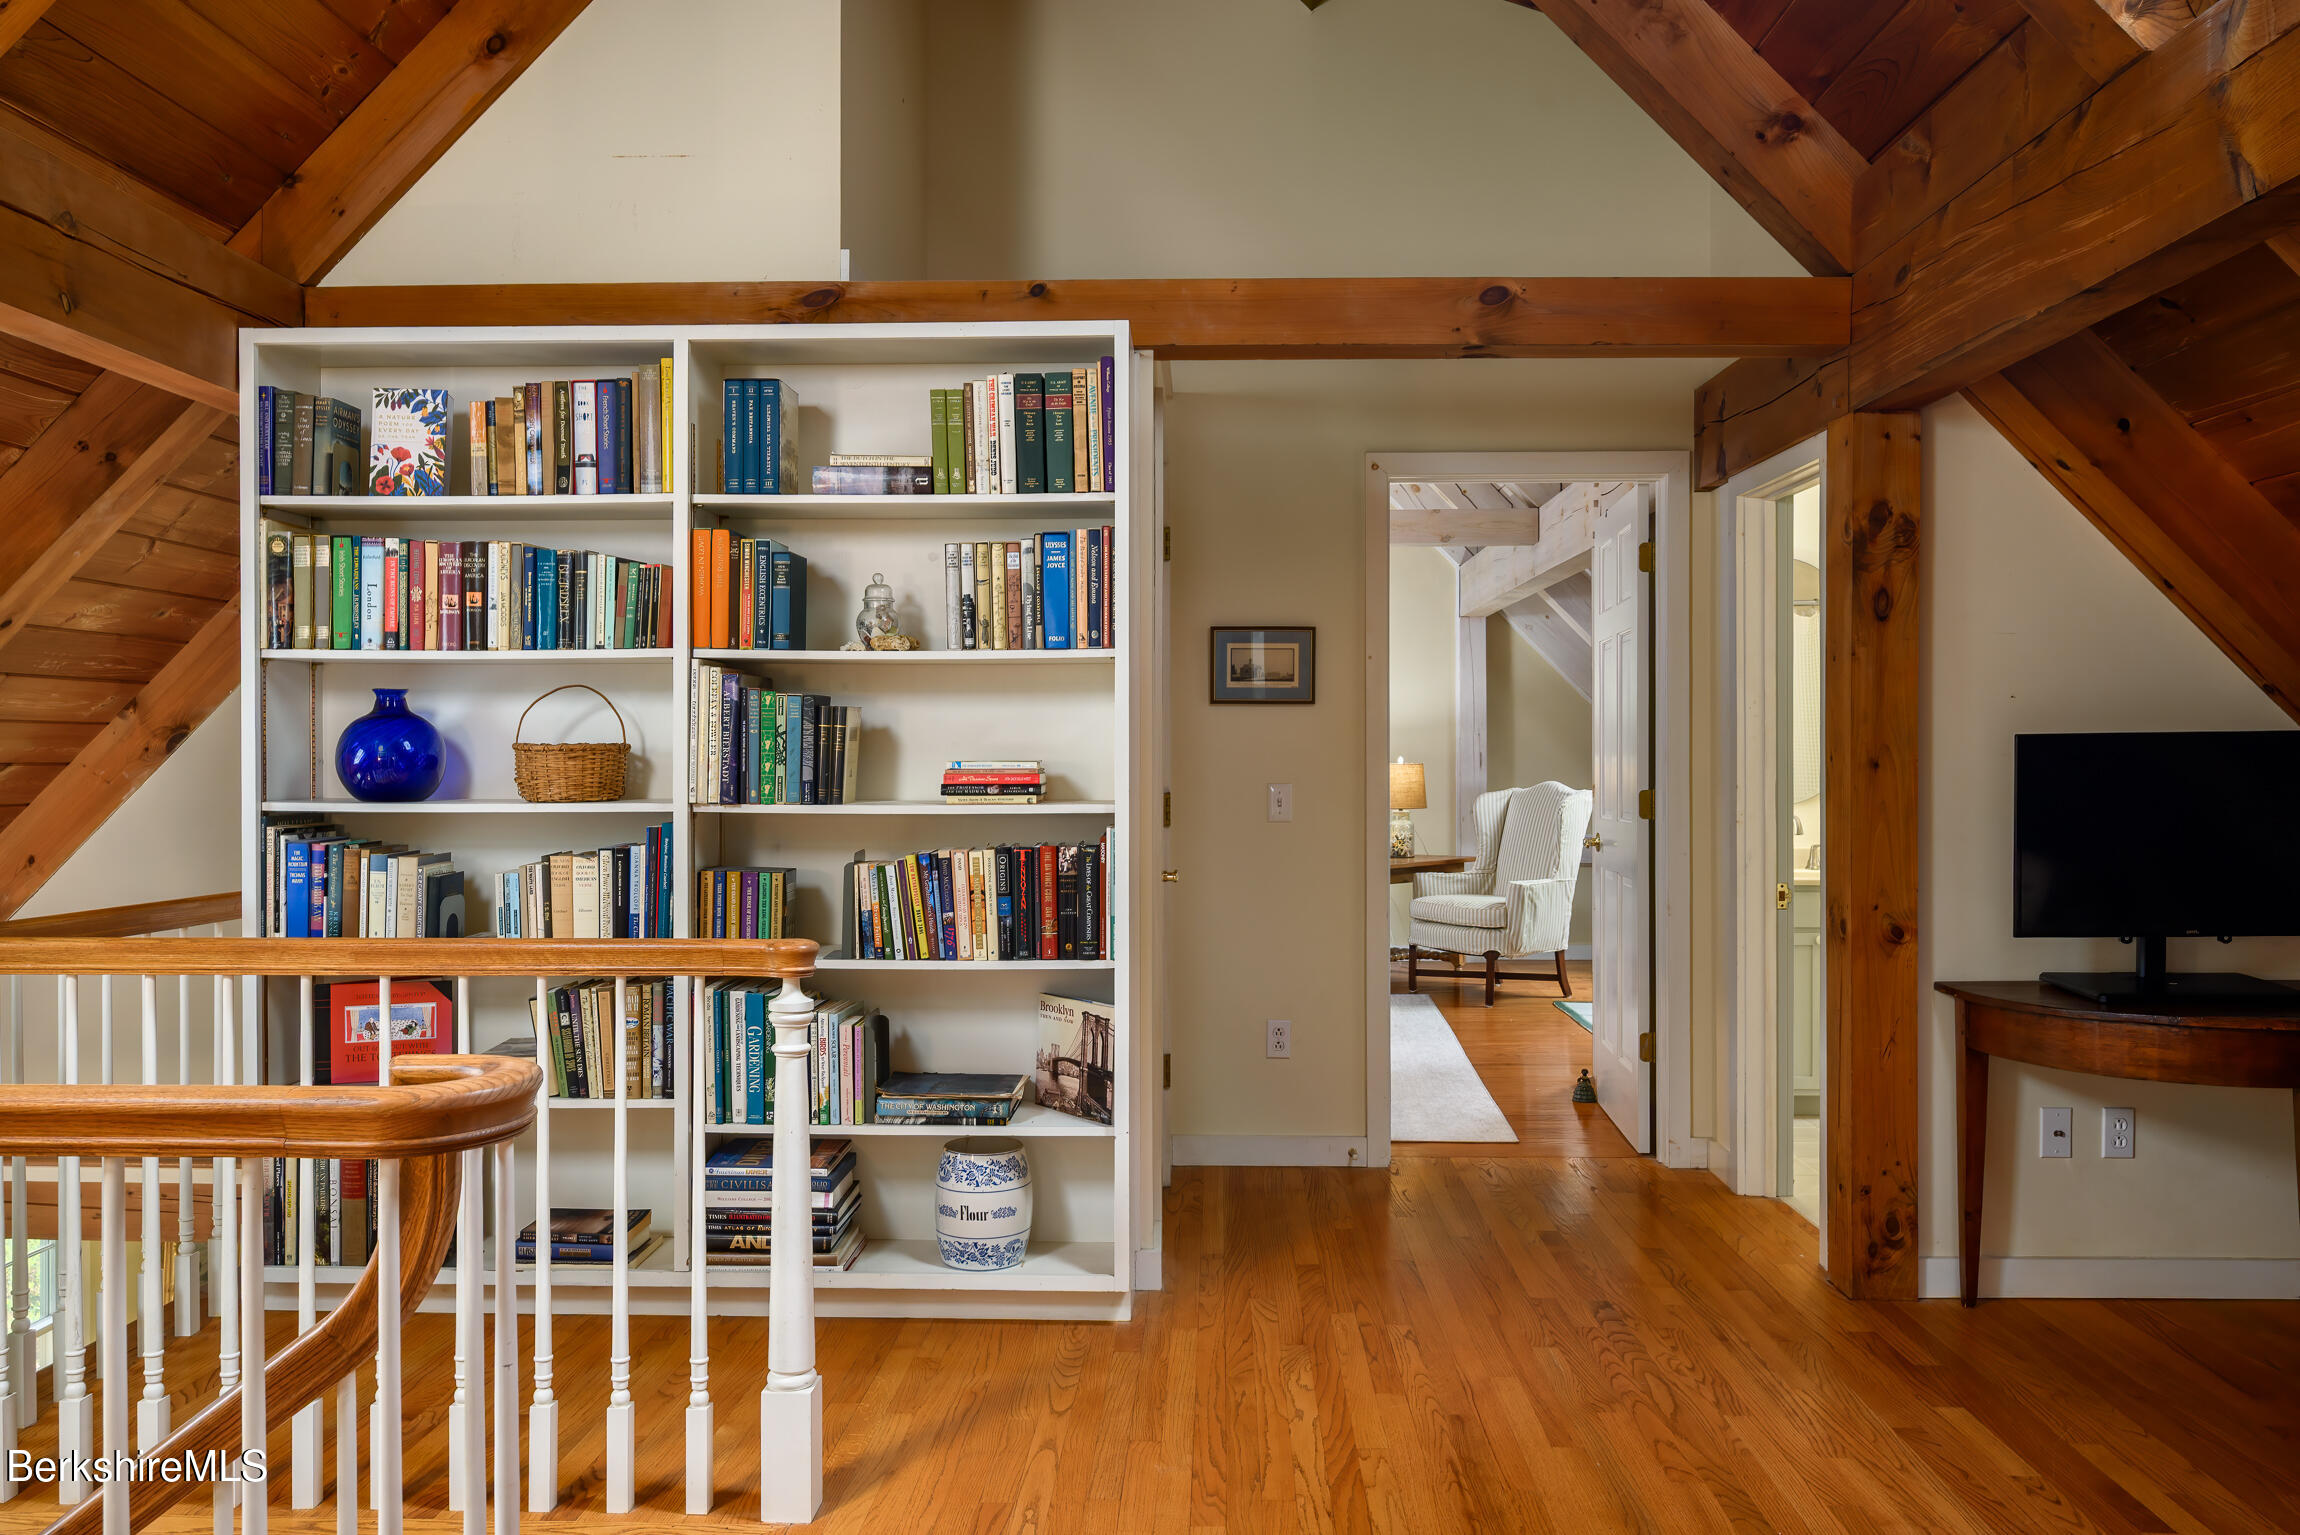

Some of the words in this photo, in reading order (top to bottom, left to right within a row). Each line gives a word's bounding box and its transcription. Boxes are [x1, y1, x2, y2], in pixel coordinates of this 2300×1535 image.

[1089, 384, 1097, 415] AVENUE
[332, 416, 362, 435] ODYSSEY
[1091, 429, 1100, 477] PRESIDENTS
[1045, 540, 1067, 549] ULYSSES
[1046, 554, 1067, 562] JAMES
[1091, 544, 1099, 567] Nelson
[500, 544, 509, 581] JOURNEYS
[758, 554, 767, 584] ENGLISH
[558, 564, 570, 624] BEARDSLEY
[698, 565, 706, 597] WOMEN
[366, 583, 378, 621] London
[758, 584, 767, 626] ECCENTRICS
[1024, 594, 1033, 616] Flying
[723, 690, 731, 729] ALBERT
[722, 731, 731, 784] BIERSTADT
[313, 863, 322, 884] TOM
[998, 856, 1007, 892] ORIGINS
[312, 885, 322, 922] BROKAW
[910, 873, 920, 907] ANTHROPOLOGY
[923, 878, 934, 917] Grandmother's
[973, 877, 982, 908] MOYERS
[944, 926, 956, 948] 1776
[975, 915, 984, 949] GENESIS
[666, 984, 674, 1023] PACIFIC
[1039, 1000, 1075, 1019] Brooklyn
[666, 1022, 674, 1046] WAR
[345, 1053, 368, 1064] THE
[746, 1025, 763, 1094] GARDENING
[842, 1043, 851, 1078] Perennials
[880, 1102, 895, 1111] THE
[895, 1102, 913, 1111] CITY
[925, 1103, 977, 1112] WASHINGTON
[720, 1179, 772, 1190] CIVILISA
[329, 1179, 338, 1229] BONSAI
[960, 1204, 990, 1222] Flour
